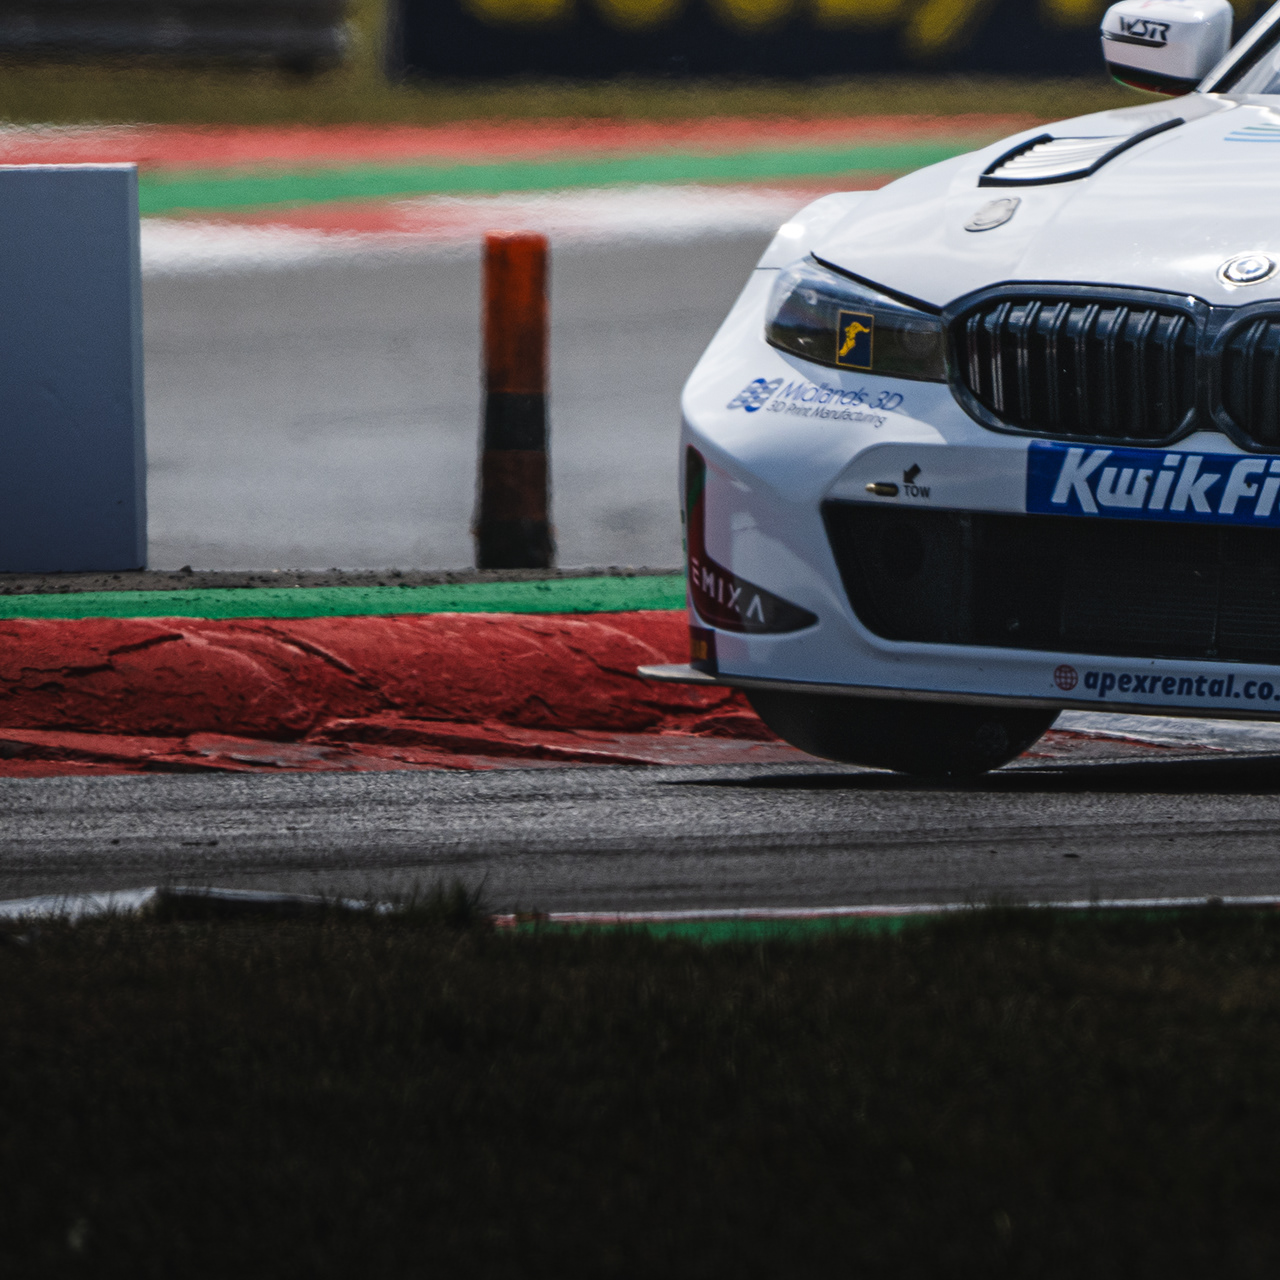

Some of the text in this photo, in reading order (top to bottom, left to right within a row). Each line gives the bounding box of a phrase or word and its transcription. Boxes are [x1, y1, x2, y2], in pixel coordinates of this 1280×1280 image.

[778, 380, 904, 411] Midlands 3D
[766, 400, 888, 428] 3D Print Manufacturing
[903, 485, 931, 498] TOW
[692, 556, 765, 624] EMIXA
